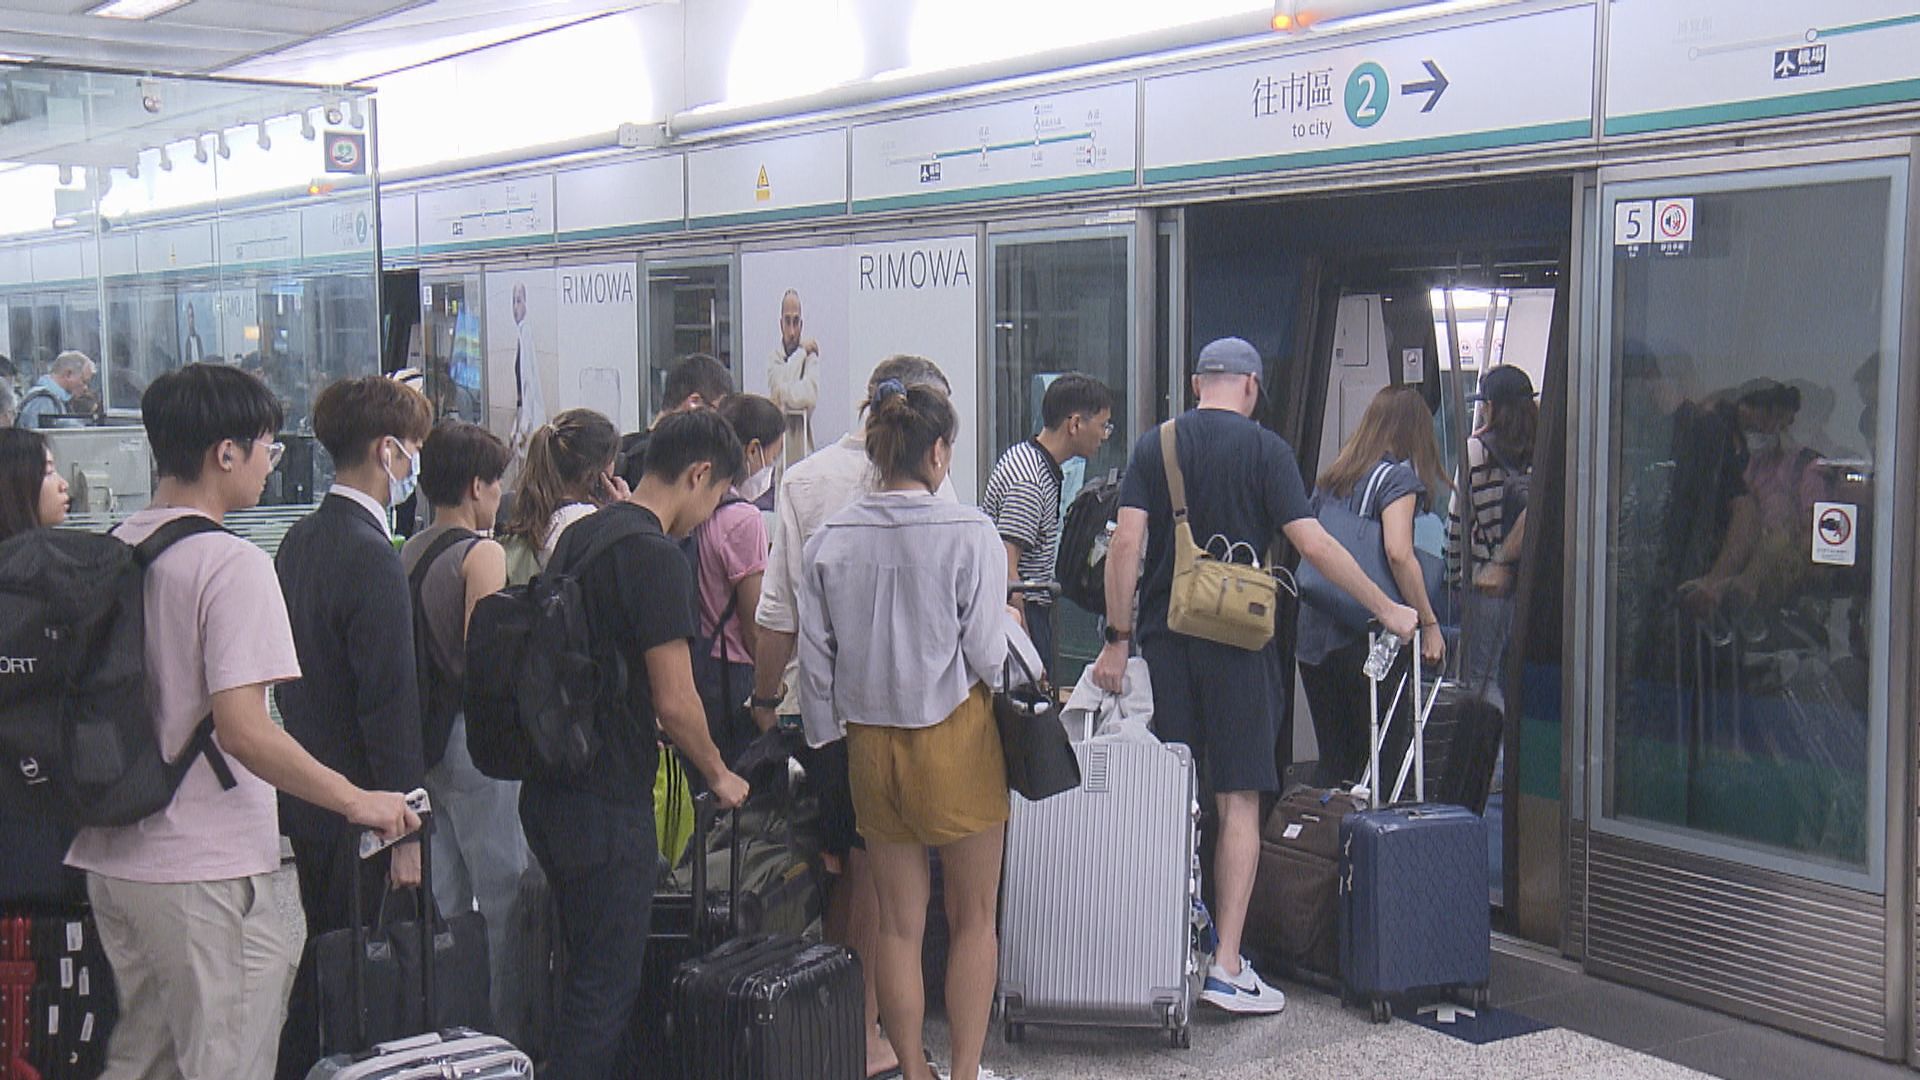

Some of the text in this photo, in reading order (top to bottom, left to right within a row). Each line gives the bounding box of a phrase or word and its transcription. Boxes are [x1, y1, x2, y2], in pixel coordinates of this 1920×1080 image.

[1252, 66, 1333, 118] 往市區
[1357, 72, 1377, 119] 2
[1292, 118, 1333, 138] to city
[1625, 208, 1641, 240] 5
[562, 270, 633, 305] RIMOWA
[860, 248, 970, 290] RIMOWA
